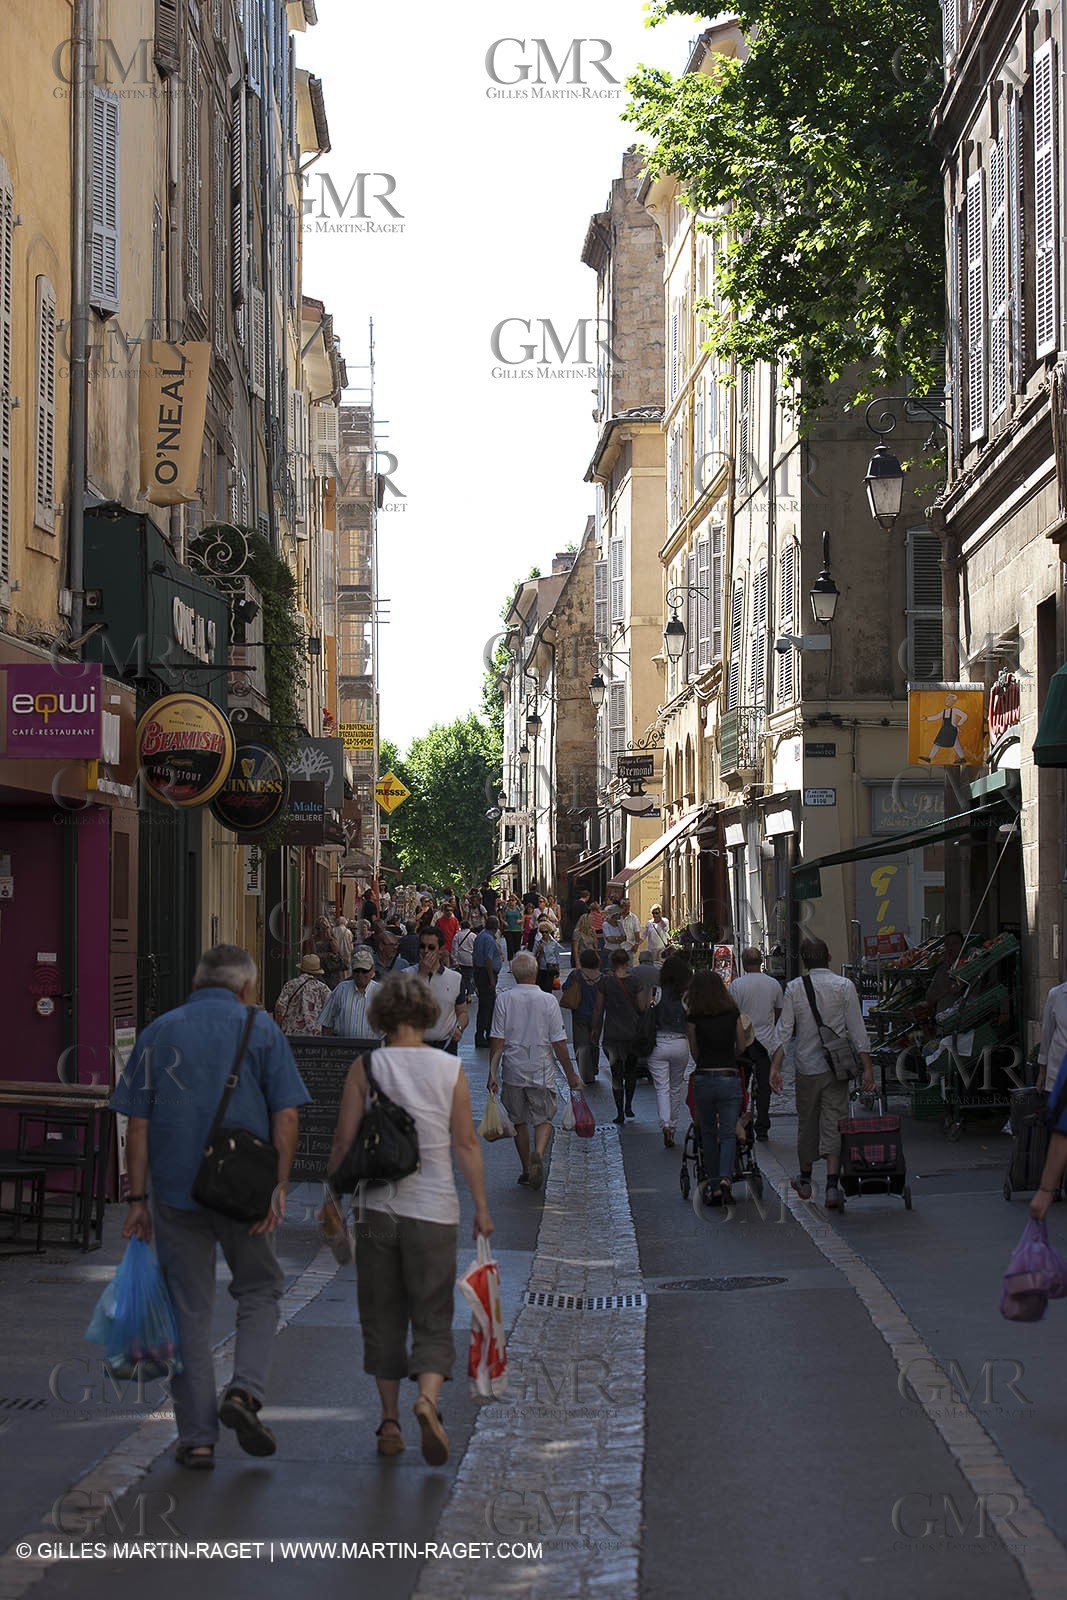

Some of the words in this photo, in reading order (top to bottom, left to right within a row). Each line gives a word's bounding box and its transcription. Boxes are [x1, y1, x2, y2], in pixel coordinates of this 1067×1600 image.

[12, 686, 95, 724] eqwi
[12, 728, 95, 736] CAFÉ-RESTAURANT
[142, 720, 224, 756] BEAMISH
[176, 769, 202, 782] STOUT
[620, 764, 652, 776] Bremond
[223, 778, 284, 794] UINNESS
[376, 789, 406, 797] PRESSE
[293, 801, 323, 812] Malte
